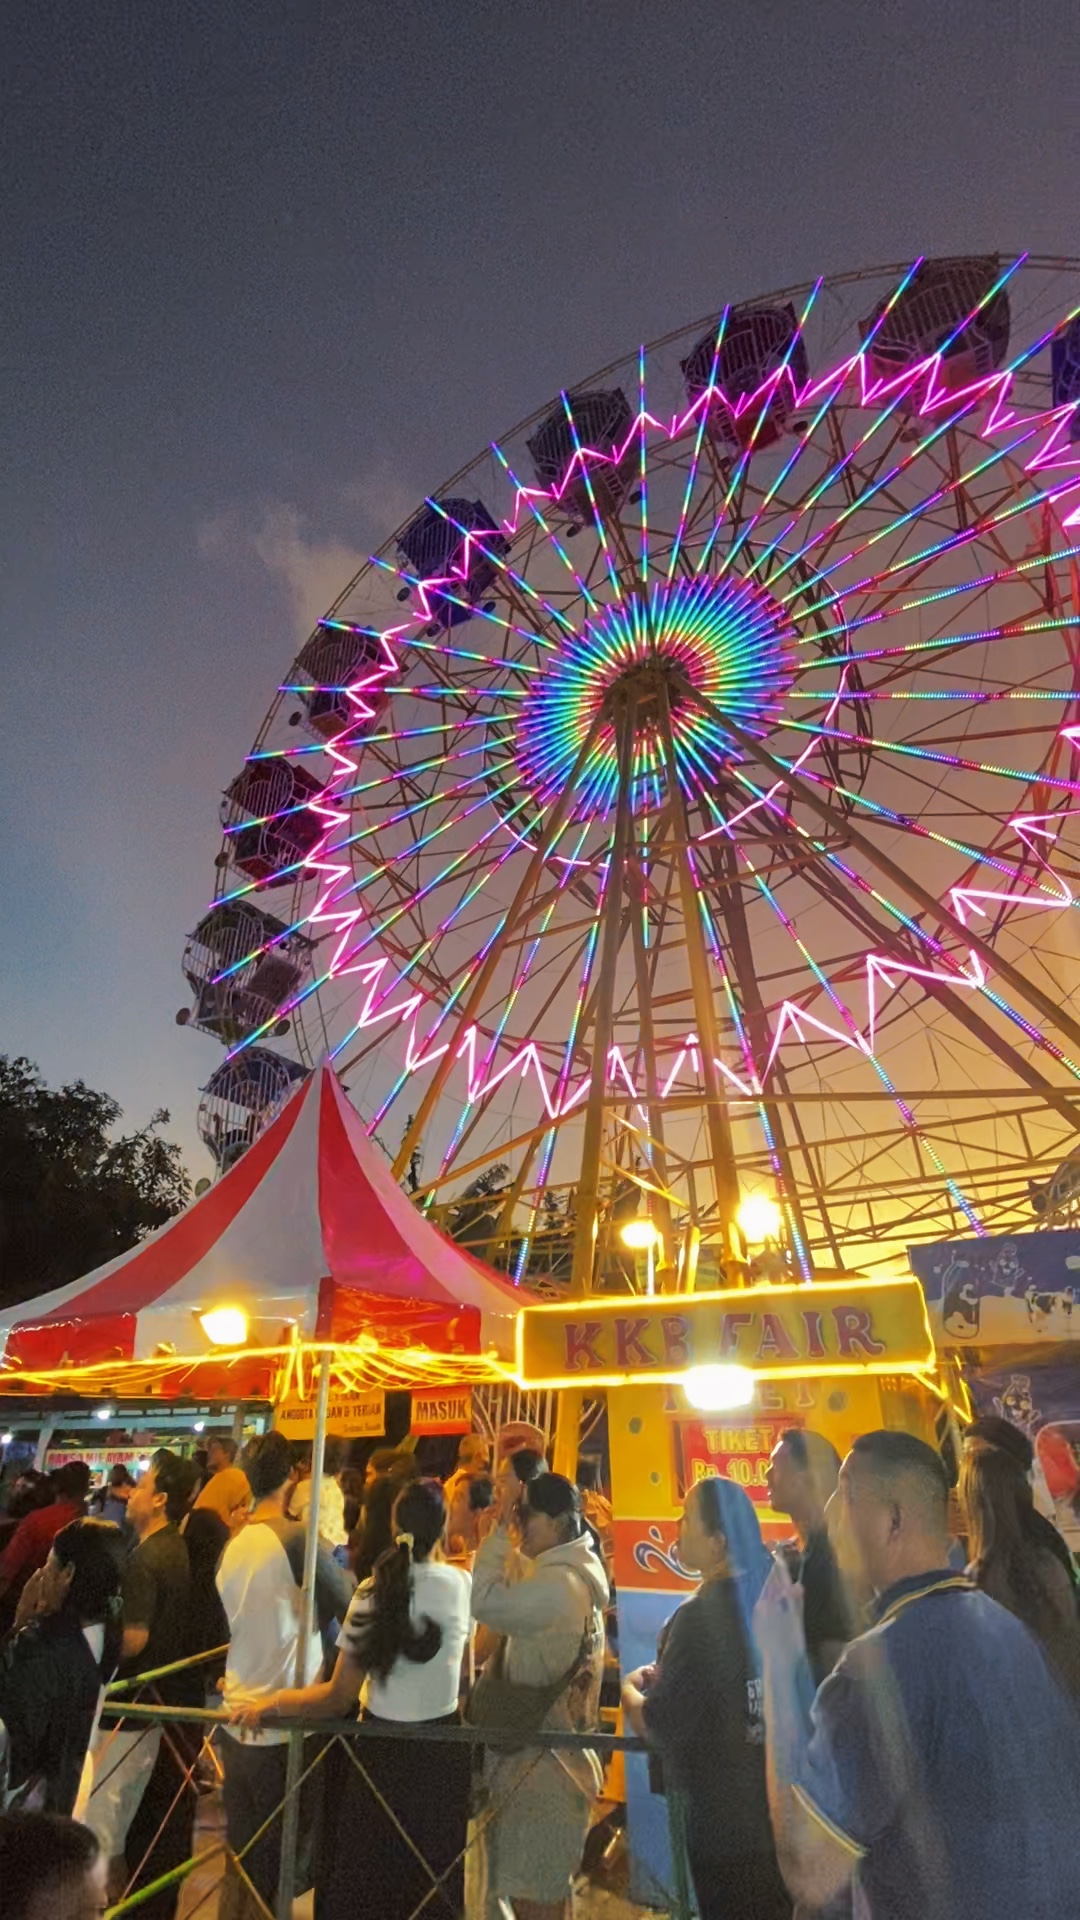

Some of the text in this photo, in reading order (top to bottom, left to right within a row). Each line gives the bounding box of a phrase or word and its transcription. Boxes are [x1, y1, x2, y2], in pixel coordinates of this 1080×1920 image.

[563, 1305, 886, 1374] KKB FAIR
[416, 1399, 467, 1420] MASUK
[704, 1428, 773, 1453] TIKET
